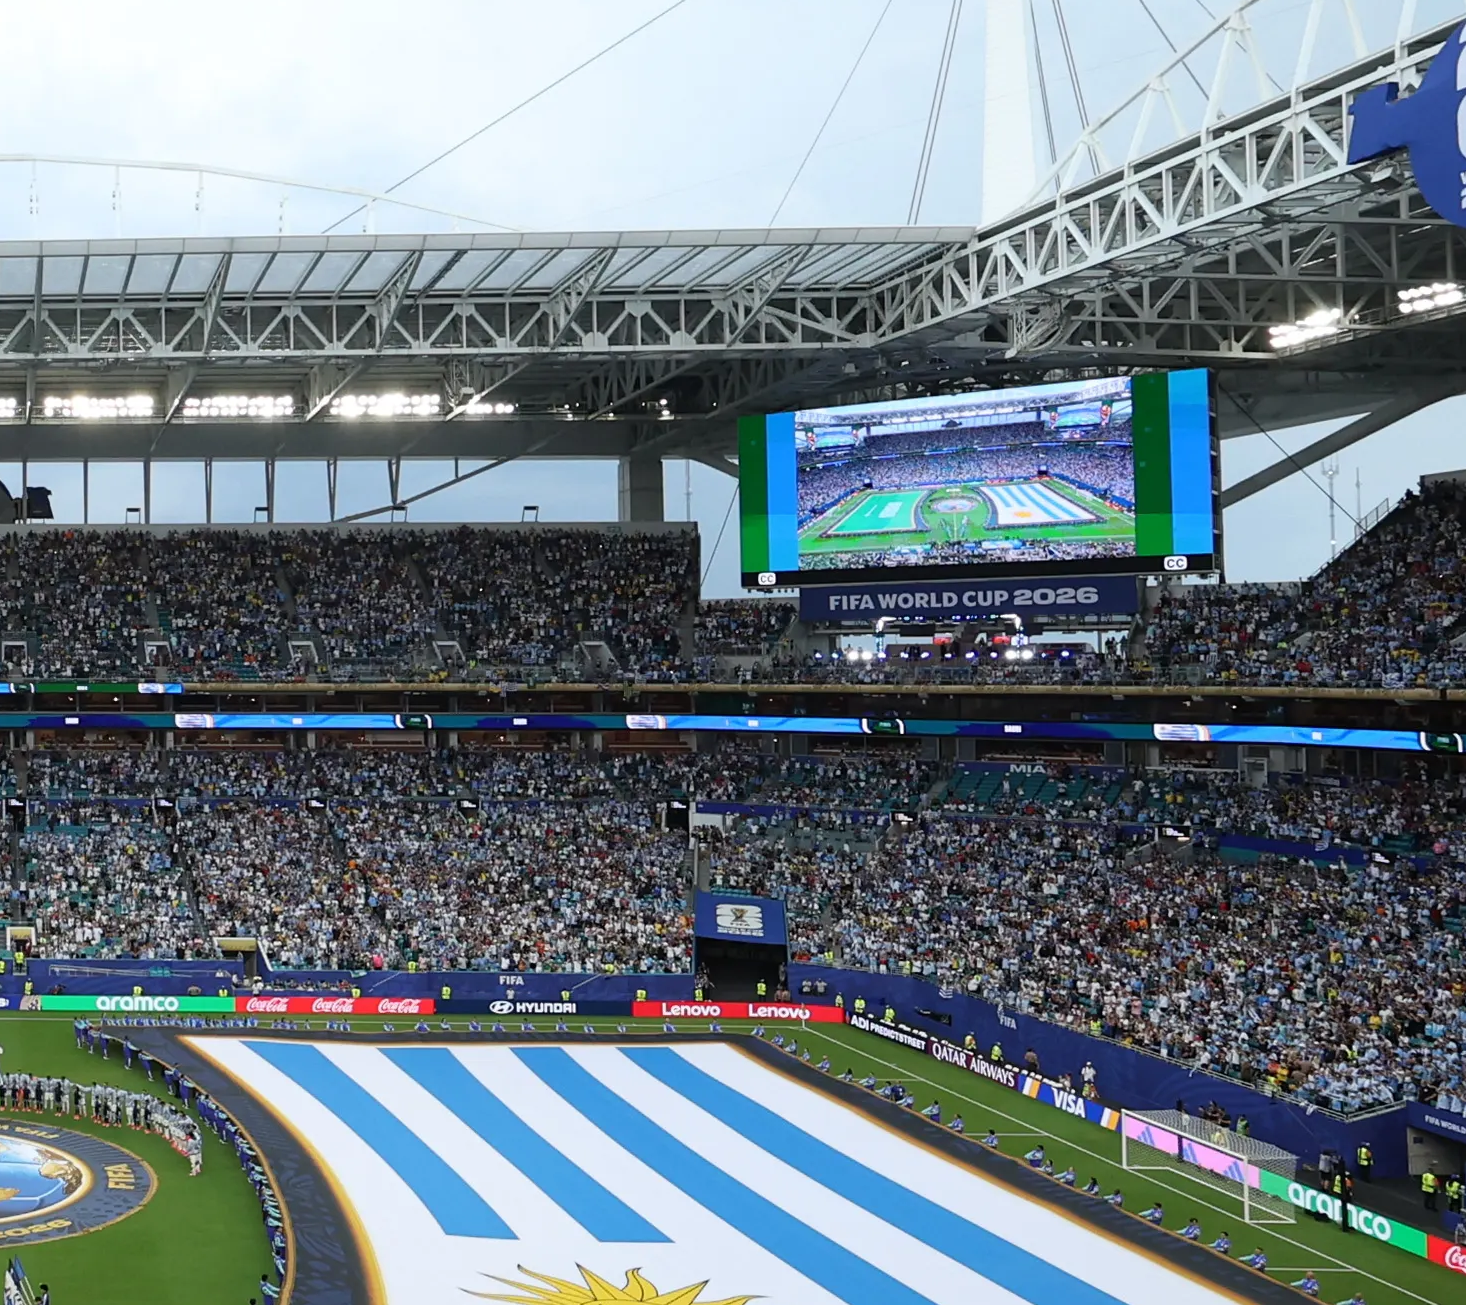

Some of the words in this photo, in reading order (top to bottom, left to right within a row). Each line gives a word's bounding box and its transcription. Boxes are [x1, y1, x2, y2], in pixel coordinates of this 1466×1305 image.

[1166, 557, 1186, 569] CC
[829, 593, 872, 611] FIFA
[875, 590, 959, 610] WORLD
[962, 589, 1009, 607] CUP
[1014, 586, 1099, 606] 2026
[499, 975, 525, 985] FIFA
[96, 995, 179, 1011] aramco
[516, 1002, 576, 1014] HYUNDAI
[662, 1001, 721, 1016] Lenovo
[748, 1002, 811, 1020] Lenovo
[851, 1014, 869, 1031] ADI
[870, 1022, 926, 1051] PREDICTSTREET
[932, 1044, 967, 1068] QATAR
[970, 1056, 1015, 1087] AIRWAYS
[1051, 1086, 1086, 1119] VISA
[1425, 1114, 1440, 1127] FIFA
[1440, 1118, 1466, 1135] WORLD
[103, 1162, 136, 1190] FIFA
